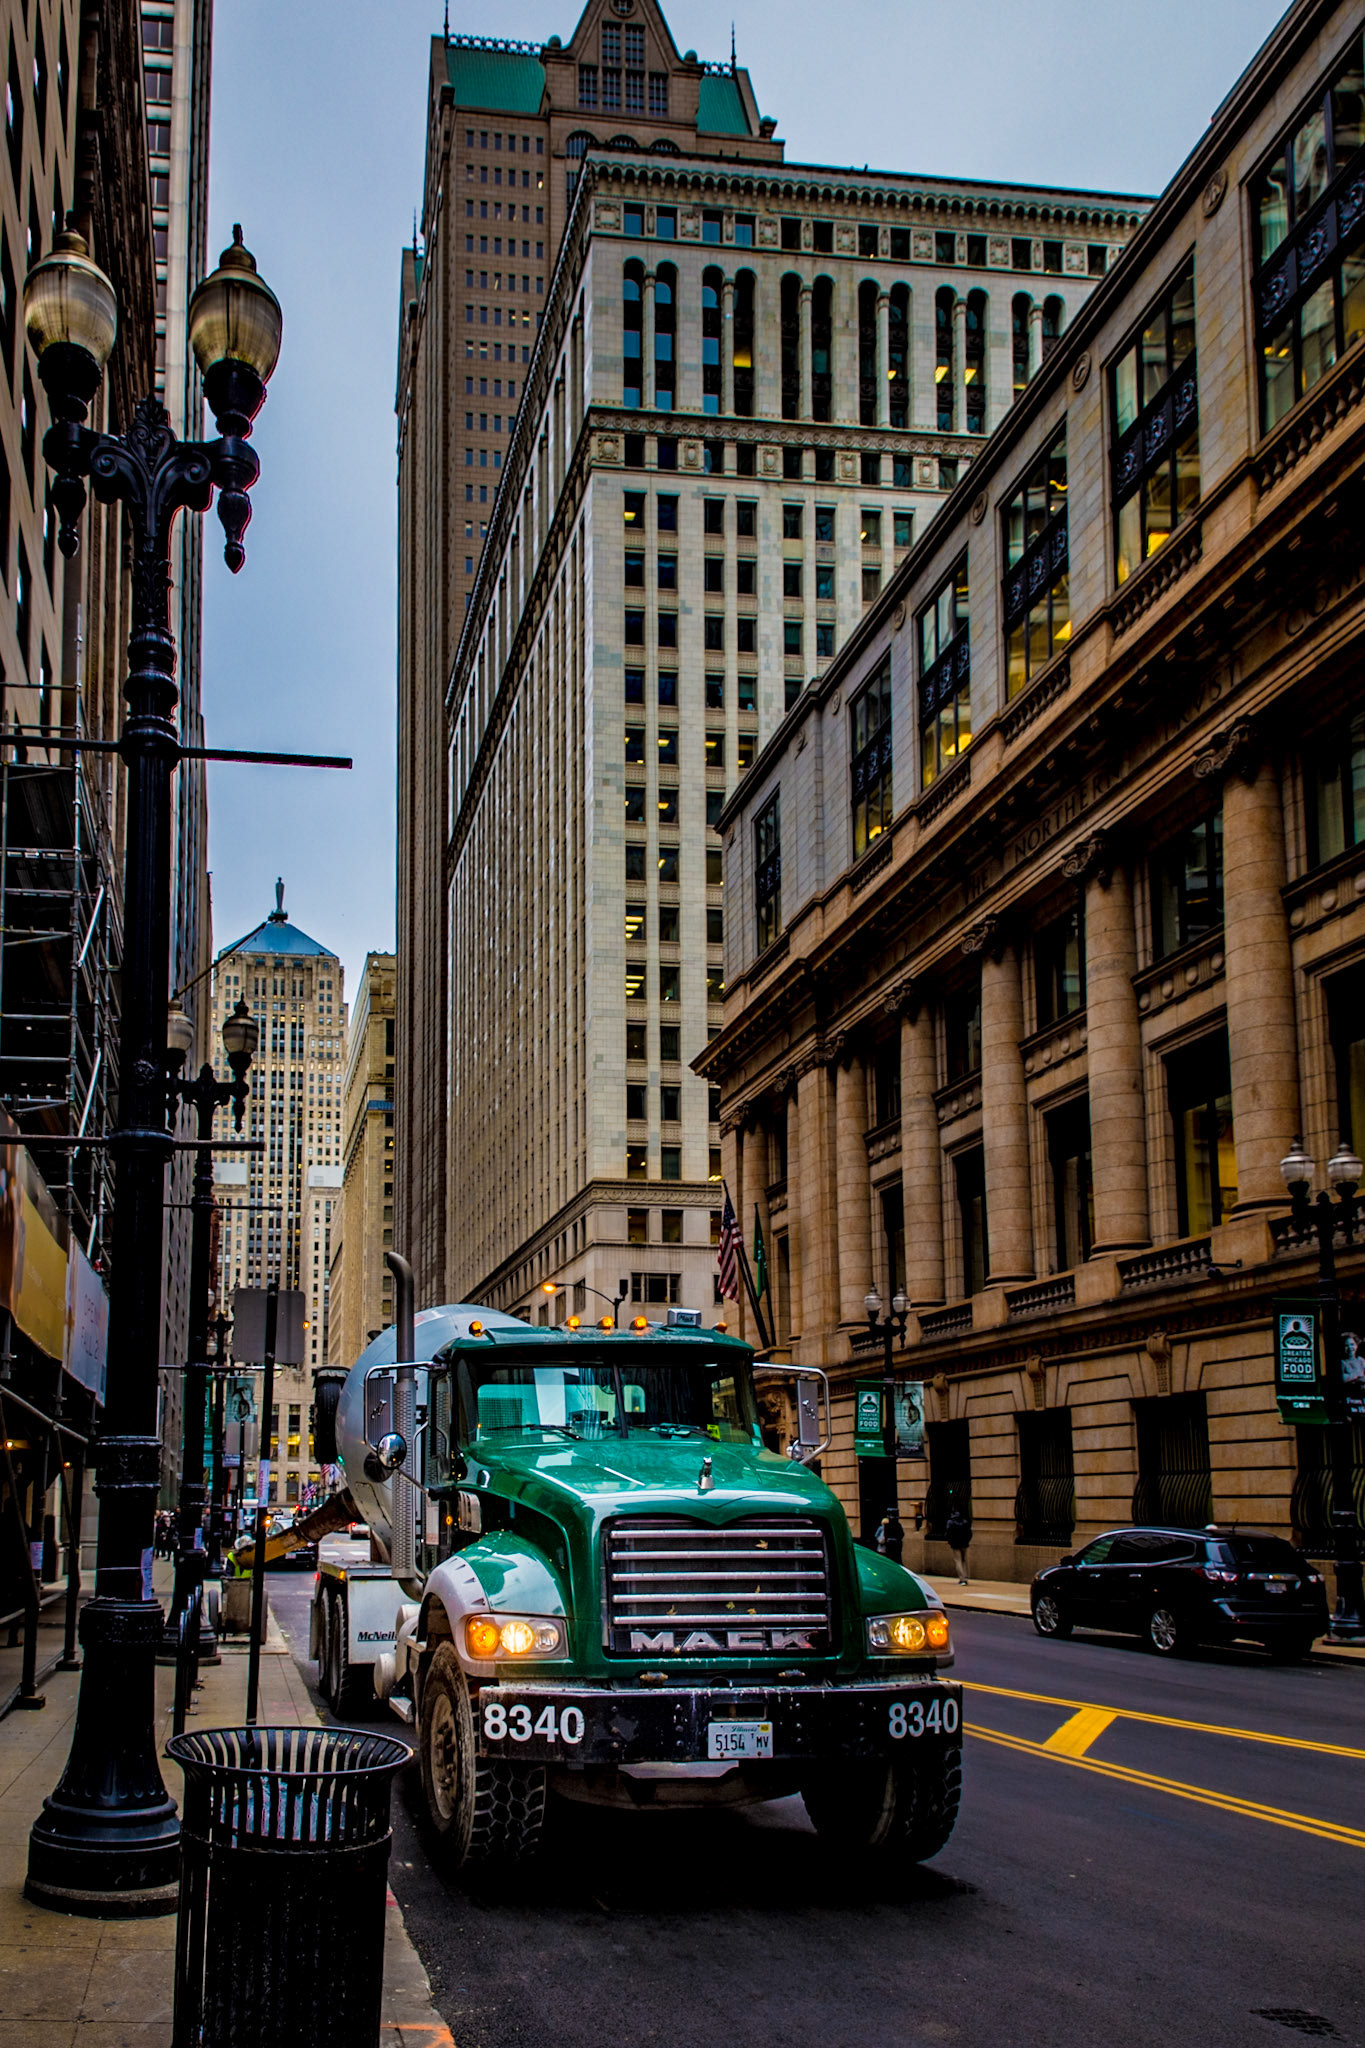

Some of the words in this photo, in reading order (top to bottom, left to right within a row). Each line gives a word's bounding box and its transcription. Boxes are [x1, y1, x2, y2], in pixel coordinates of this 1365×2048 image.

[1283, 1364, 1313, 1373] FOOD
[358, 1631, 397, 1640] McNeil
[630, 1630, 817, 1651] MACK
[484, 1703, 585, 1744] 8340
[889, 1698, 959, 1739] 8340
[716, 1733, 745, 1750] 5154
